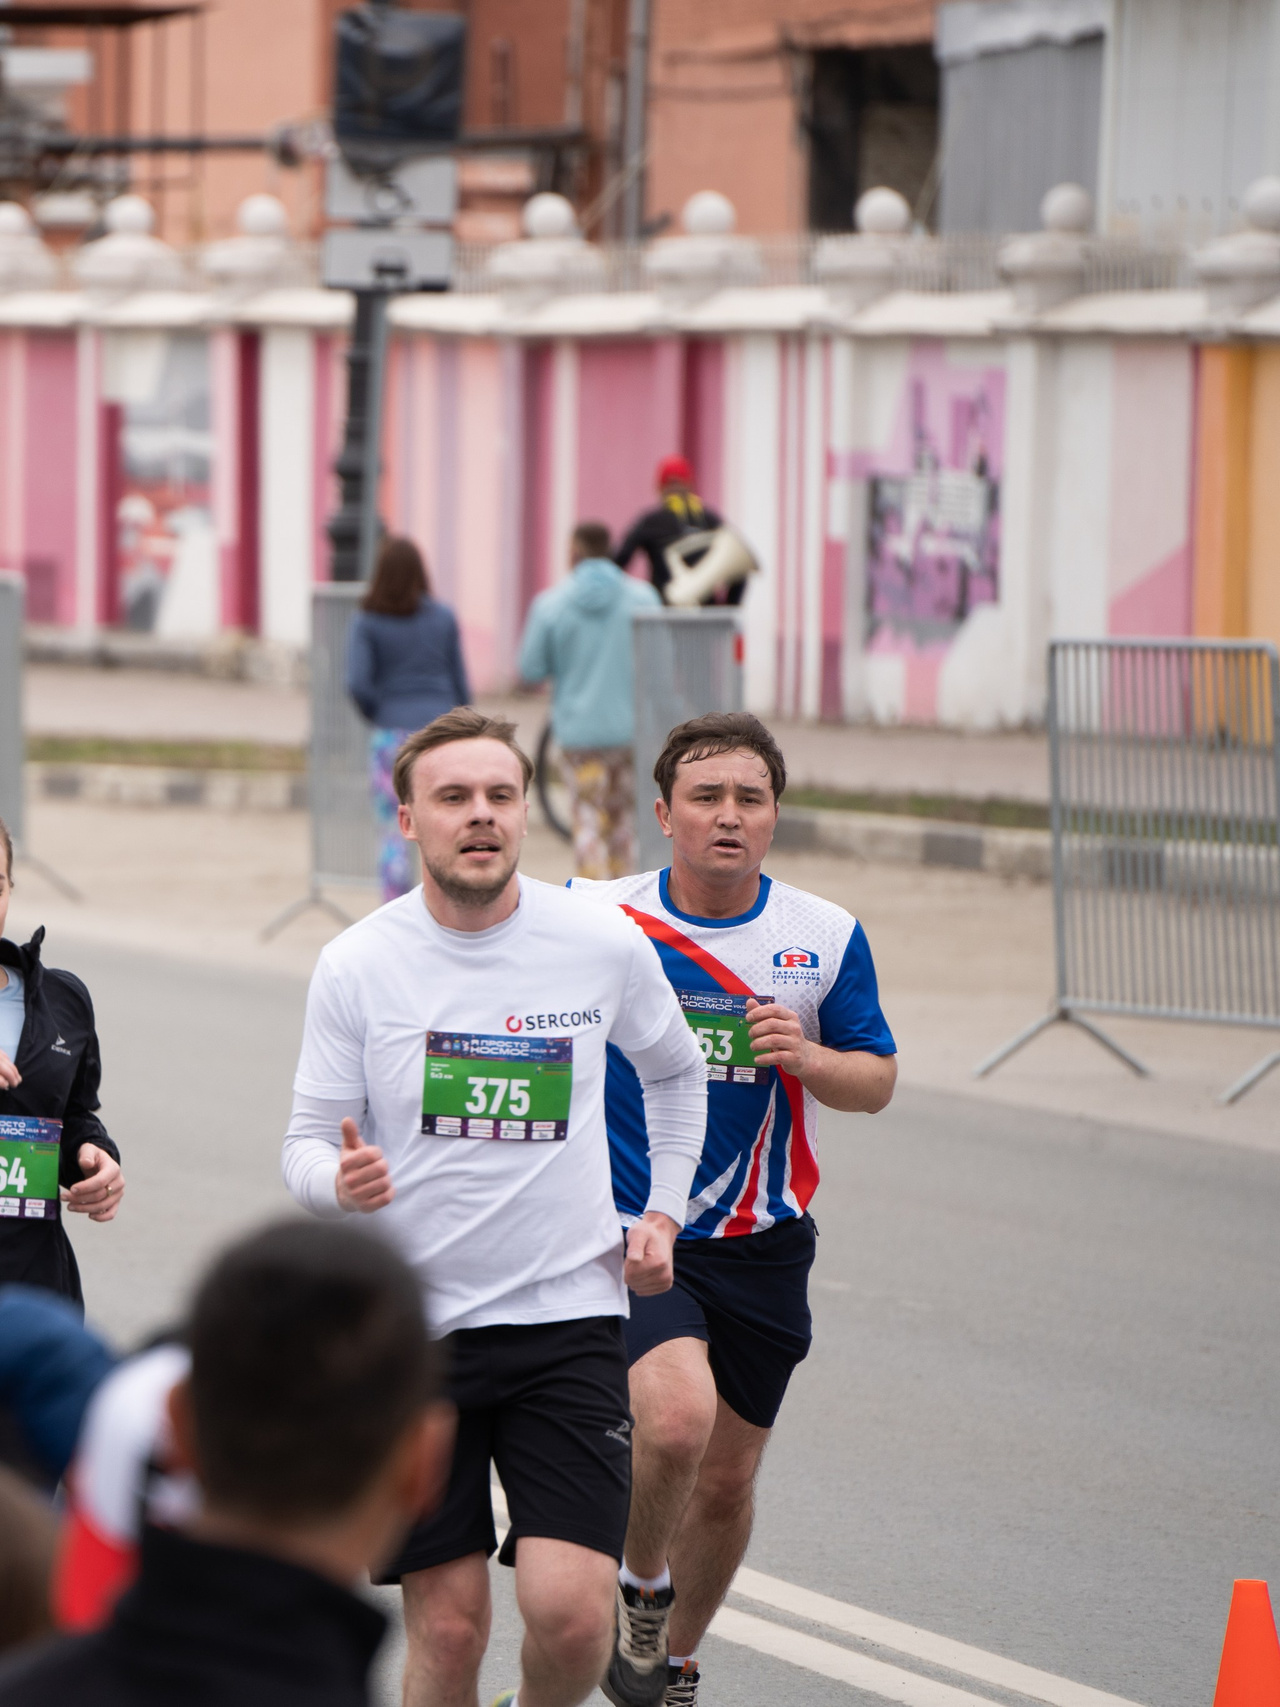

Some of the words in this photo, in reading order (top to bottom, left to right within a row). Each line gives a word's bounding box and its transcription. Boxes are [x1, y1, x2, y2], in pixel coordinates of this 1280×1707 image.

[689, 995, 733, 1004] ПРОСТО
[680, 1000, 732, 1011] КОСМОС
[525, 1009, 602, 1030] SERCONS
[480, 1040, 530, 1049] ПРОСТО
[690, 1027, 733, 1061] 53
[470, 1046, 530, 1057] КОСМОС
[465, 1076, 531, 1117] 375
